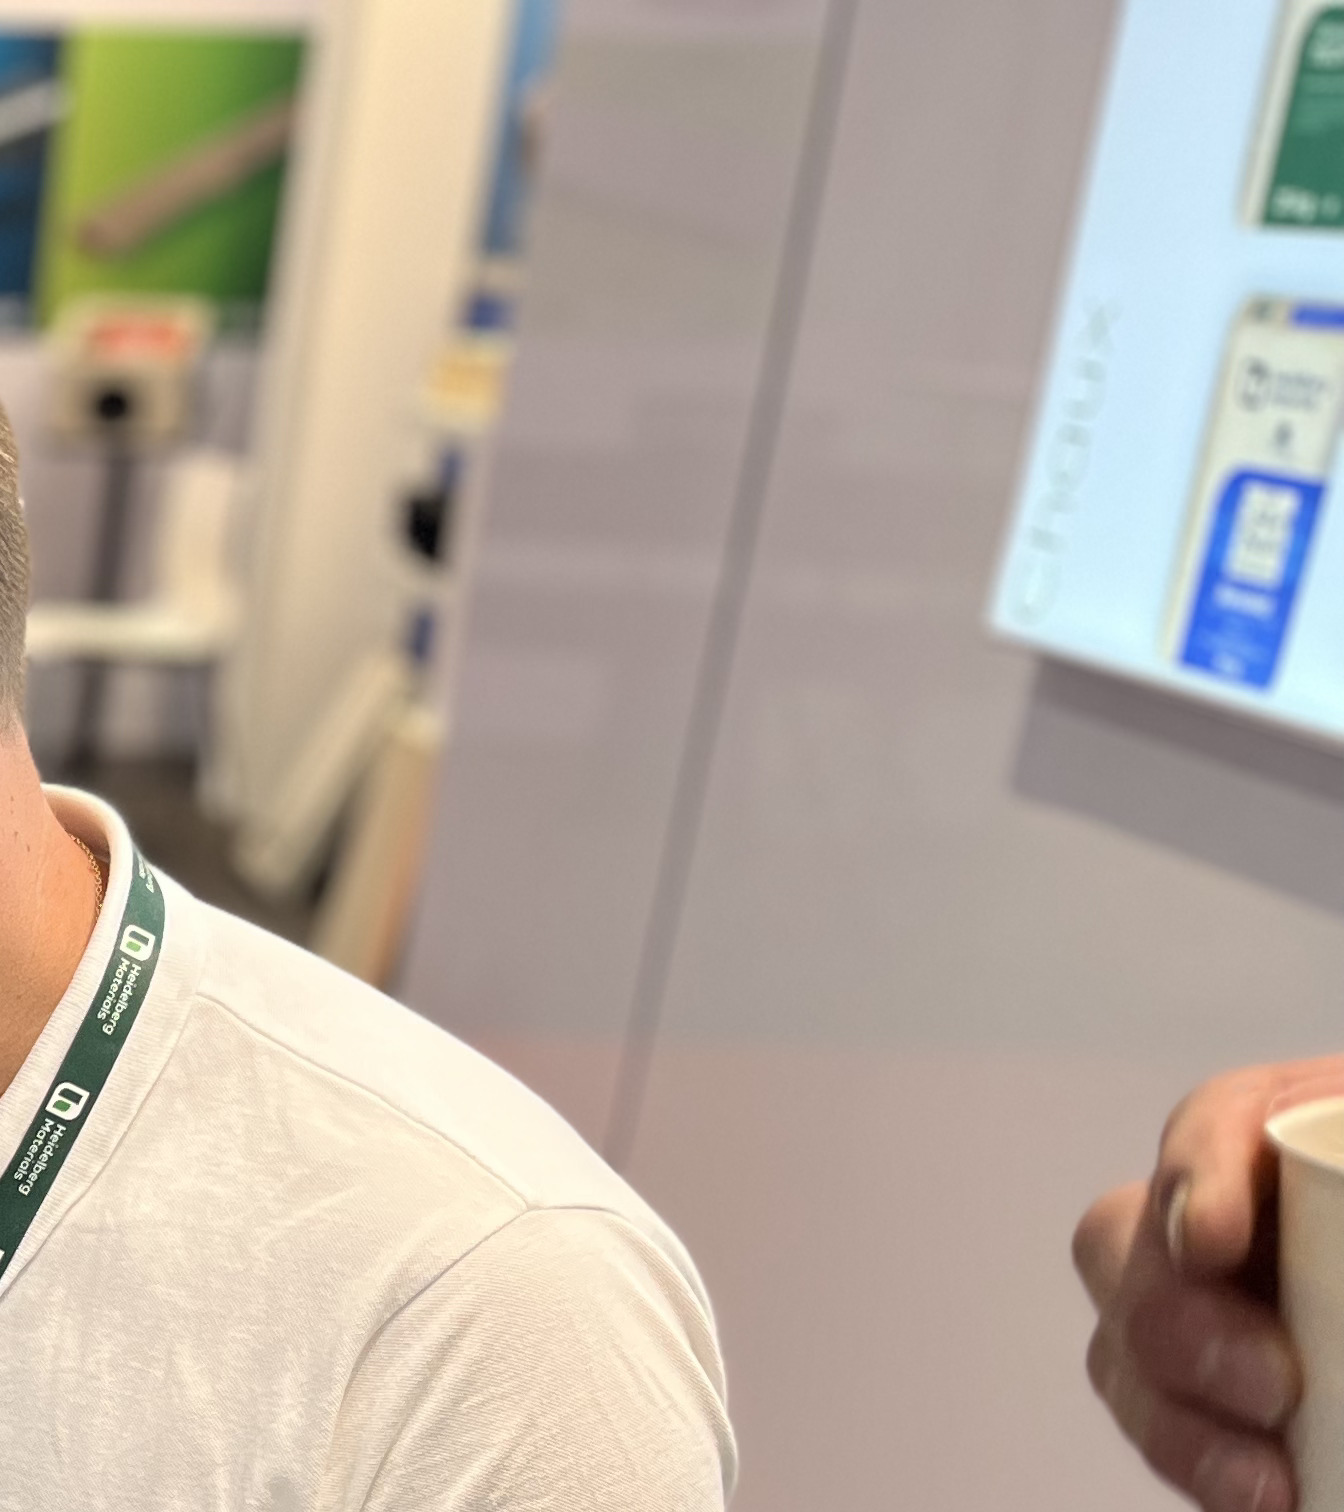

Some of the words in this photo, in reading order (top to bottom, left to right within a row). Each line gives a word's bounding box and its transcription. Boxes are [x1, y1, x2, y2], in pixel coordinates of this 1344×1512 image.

[97, 958, 130, 1020] Materials
[103, 964, 141, 1036] Heidelberg
[14, 1118, 54, 1180] Materials
[18, 1124, 66, 1196] Heidelberg
